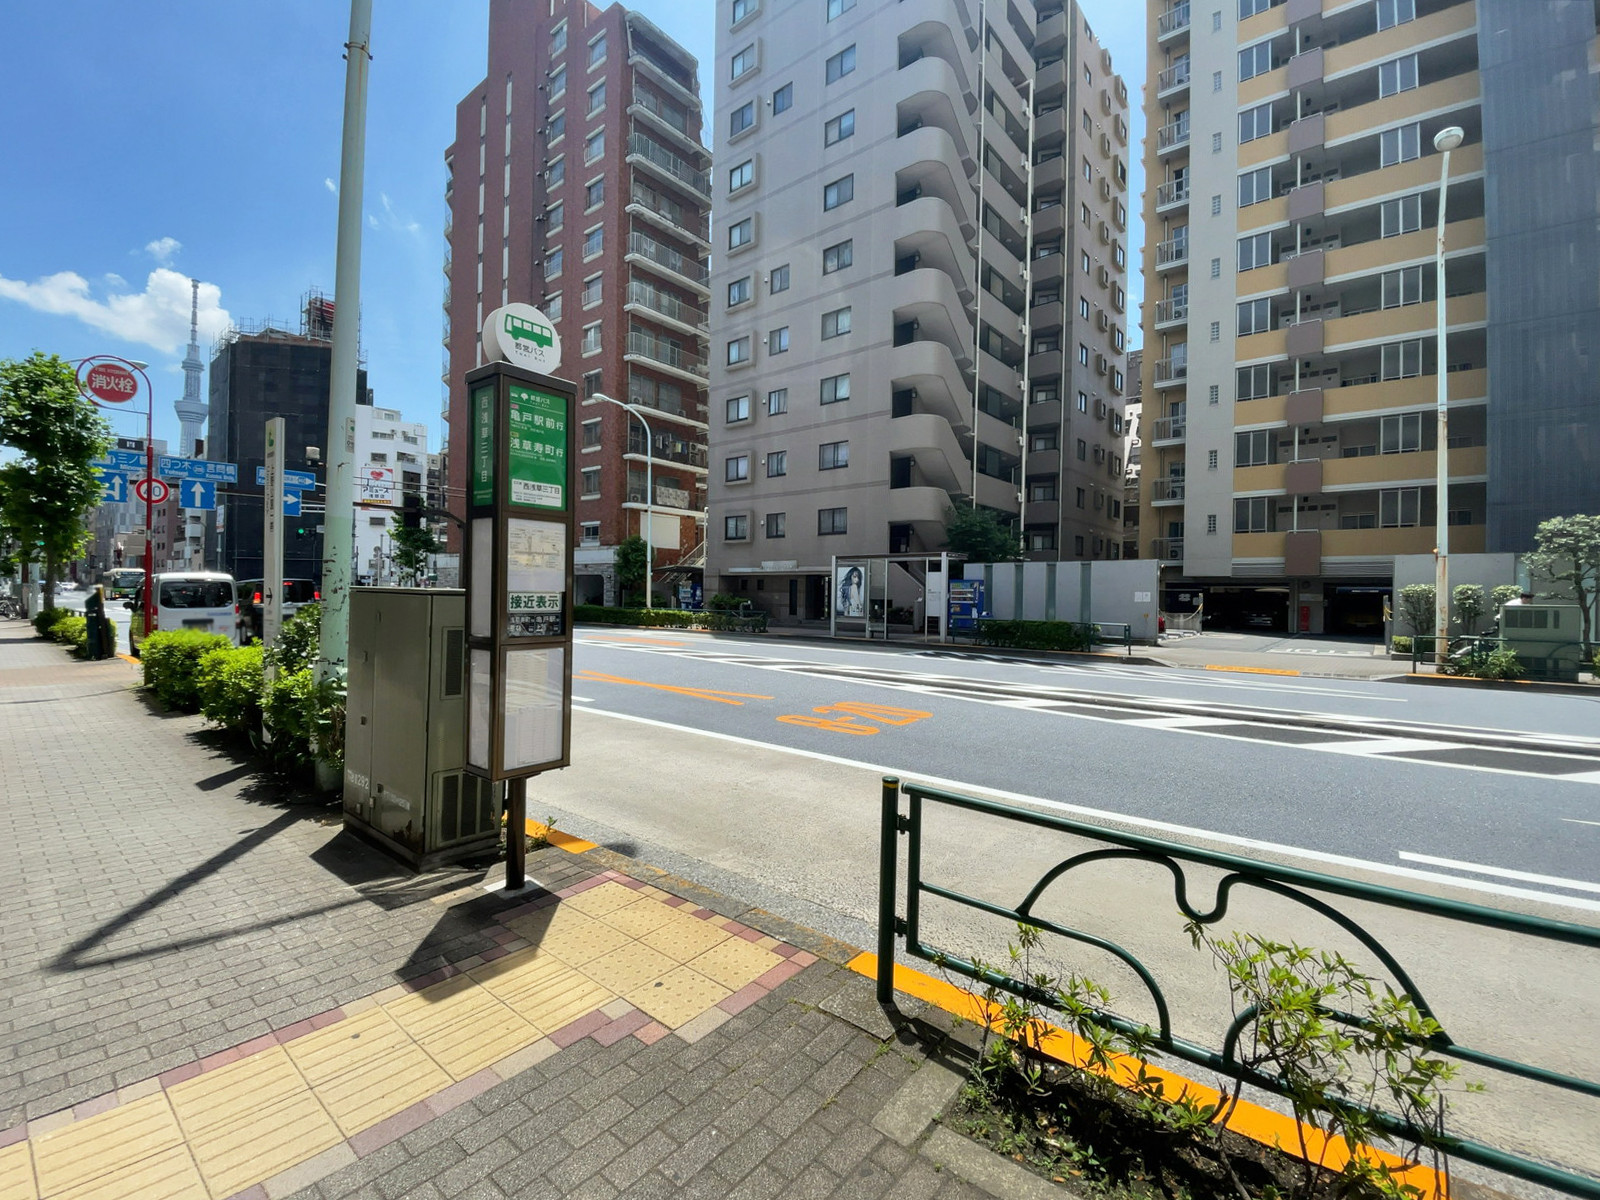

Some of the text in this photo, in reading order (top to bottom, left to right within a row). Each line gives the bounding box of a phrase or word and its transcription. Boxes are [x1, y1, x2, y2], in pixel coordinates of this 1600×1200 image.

[91, 373, 134, 393] 消火栓
[510, 410, 564, 431] 亀戸駅前行
[510, 437, 564, 457] 浅草寿町行
[161, 458, 191, 470] 四つ木
[510, 594, 559, 609] 接近表示
